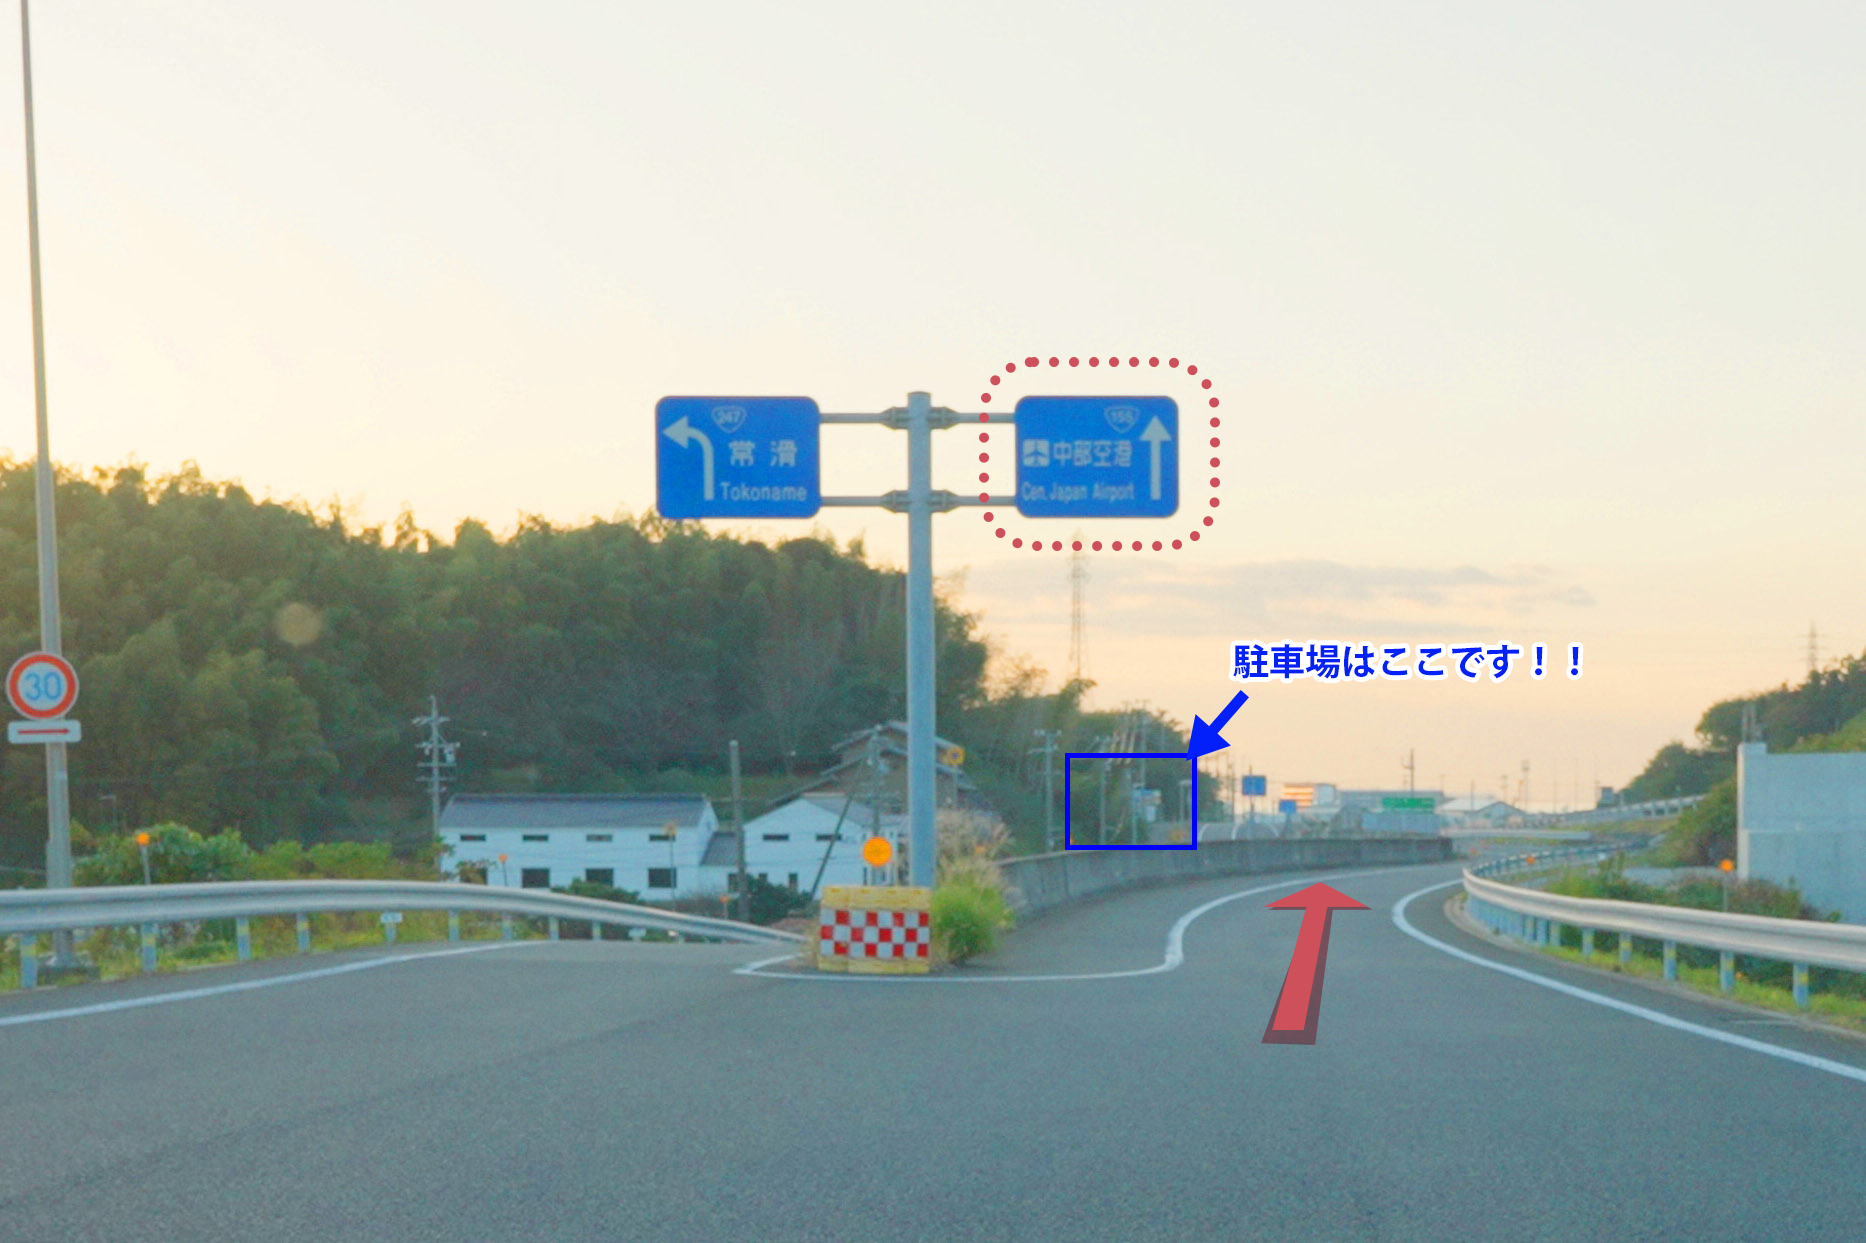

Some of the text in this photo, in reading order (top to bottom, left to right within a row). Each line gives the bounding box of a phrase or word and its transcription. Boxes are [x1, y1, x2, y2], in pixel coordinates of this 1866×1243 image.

[1053, 439, 1133, 468] 中部空港
[720, 481, 807, 501] Tokoname
[1092, 482, 1135, 504] Airport
[24, 671, 62, 701] 30
